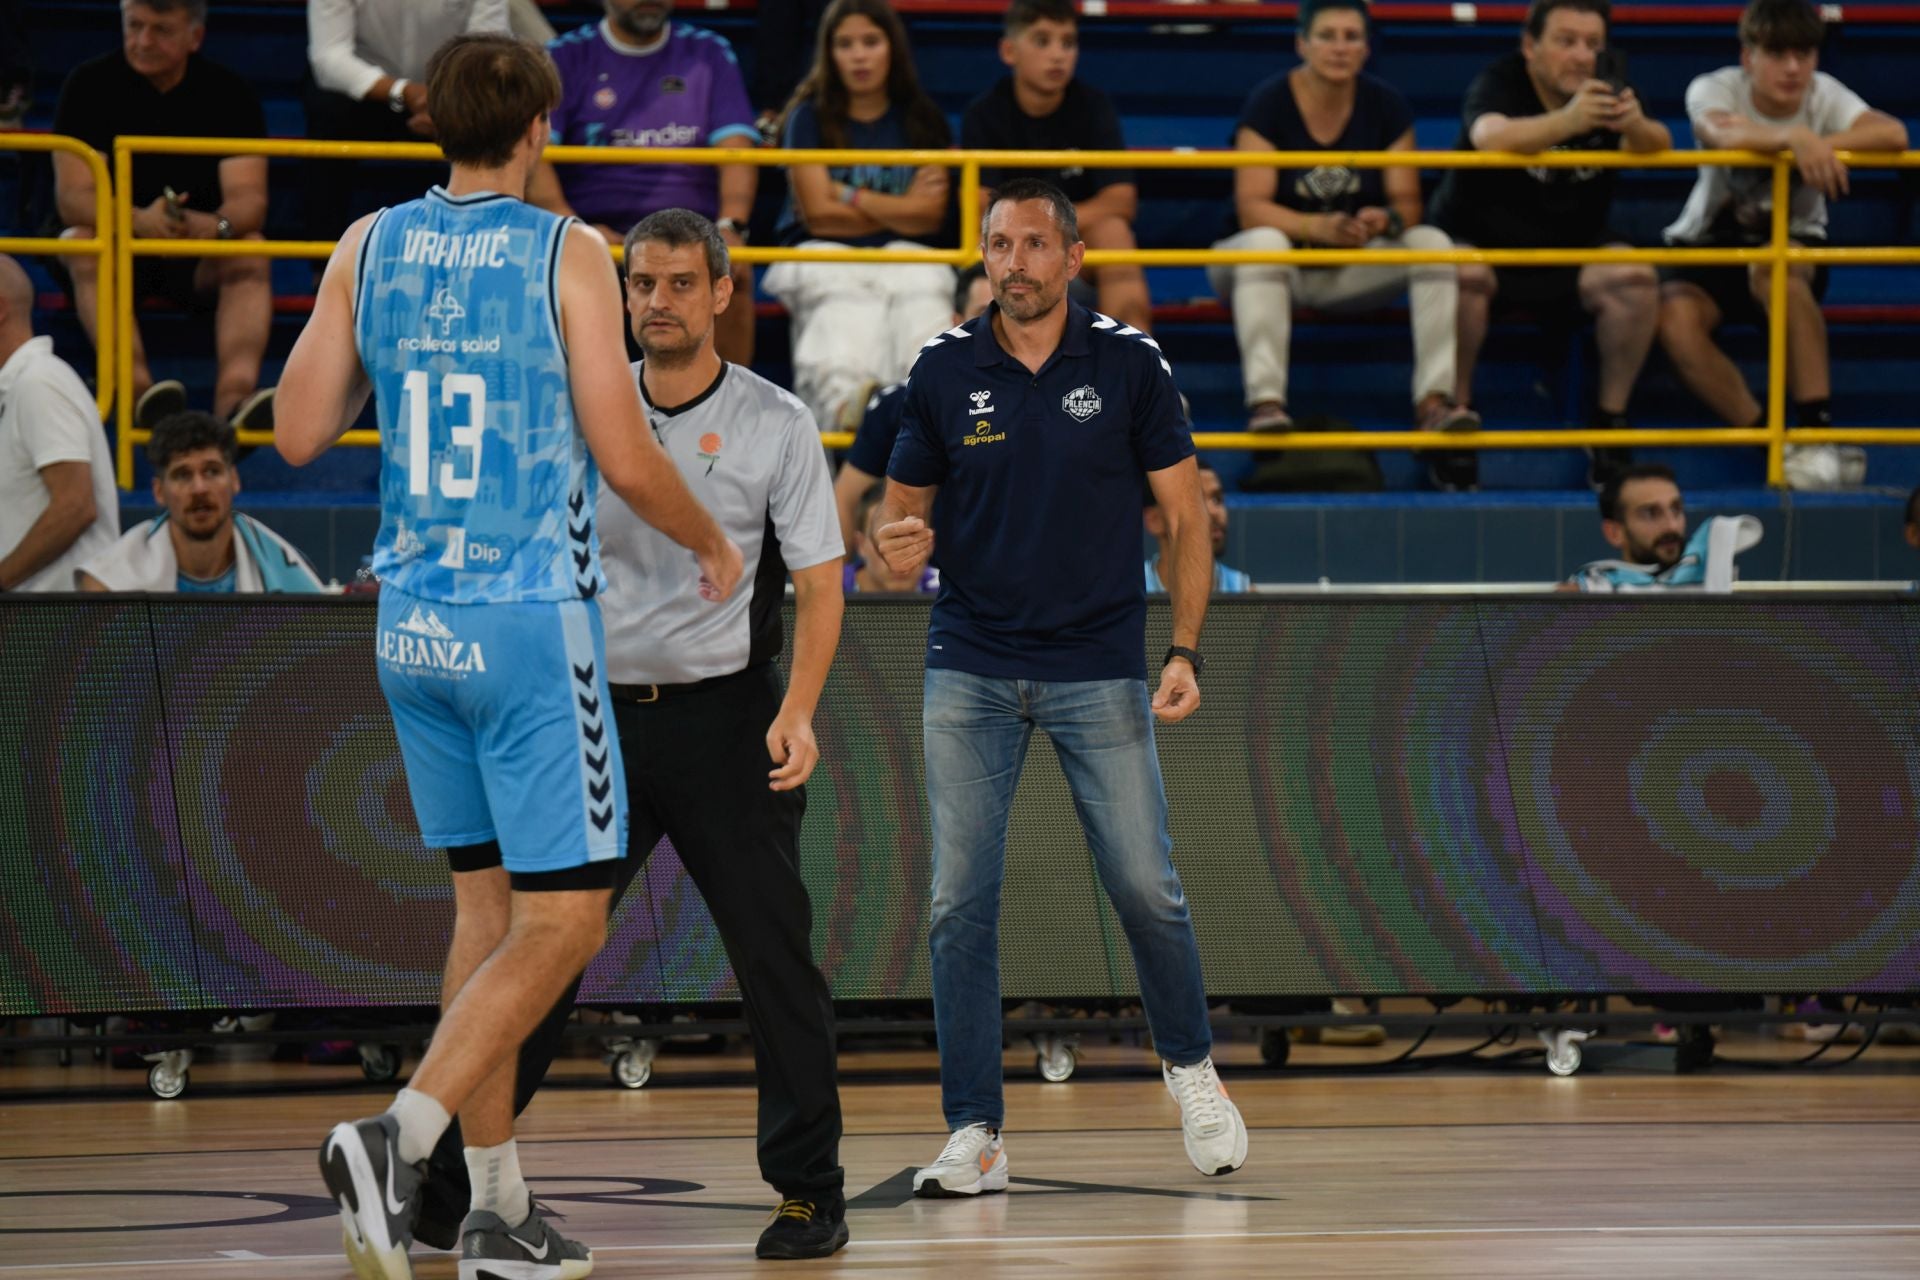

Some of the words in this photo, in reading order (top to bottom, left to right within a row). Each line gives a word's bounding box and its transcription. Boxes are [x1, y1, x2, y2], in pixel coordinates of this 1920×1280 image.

[403, 225, 509, 268] VRANKIĆ
[397, 333, 457, 353] recoleas
[461, 335, 501, 353] salud
[968, 405, 995, 416] hummel
[1064, 398, 1100, 411] PALENCIA
[403, 370, 487, 498] 13
[963, 432, 1006, 446] agropal
[468, 542, 502, 563] Dip
